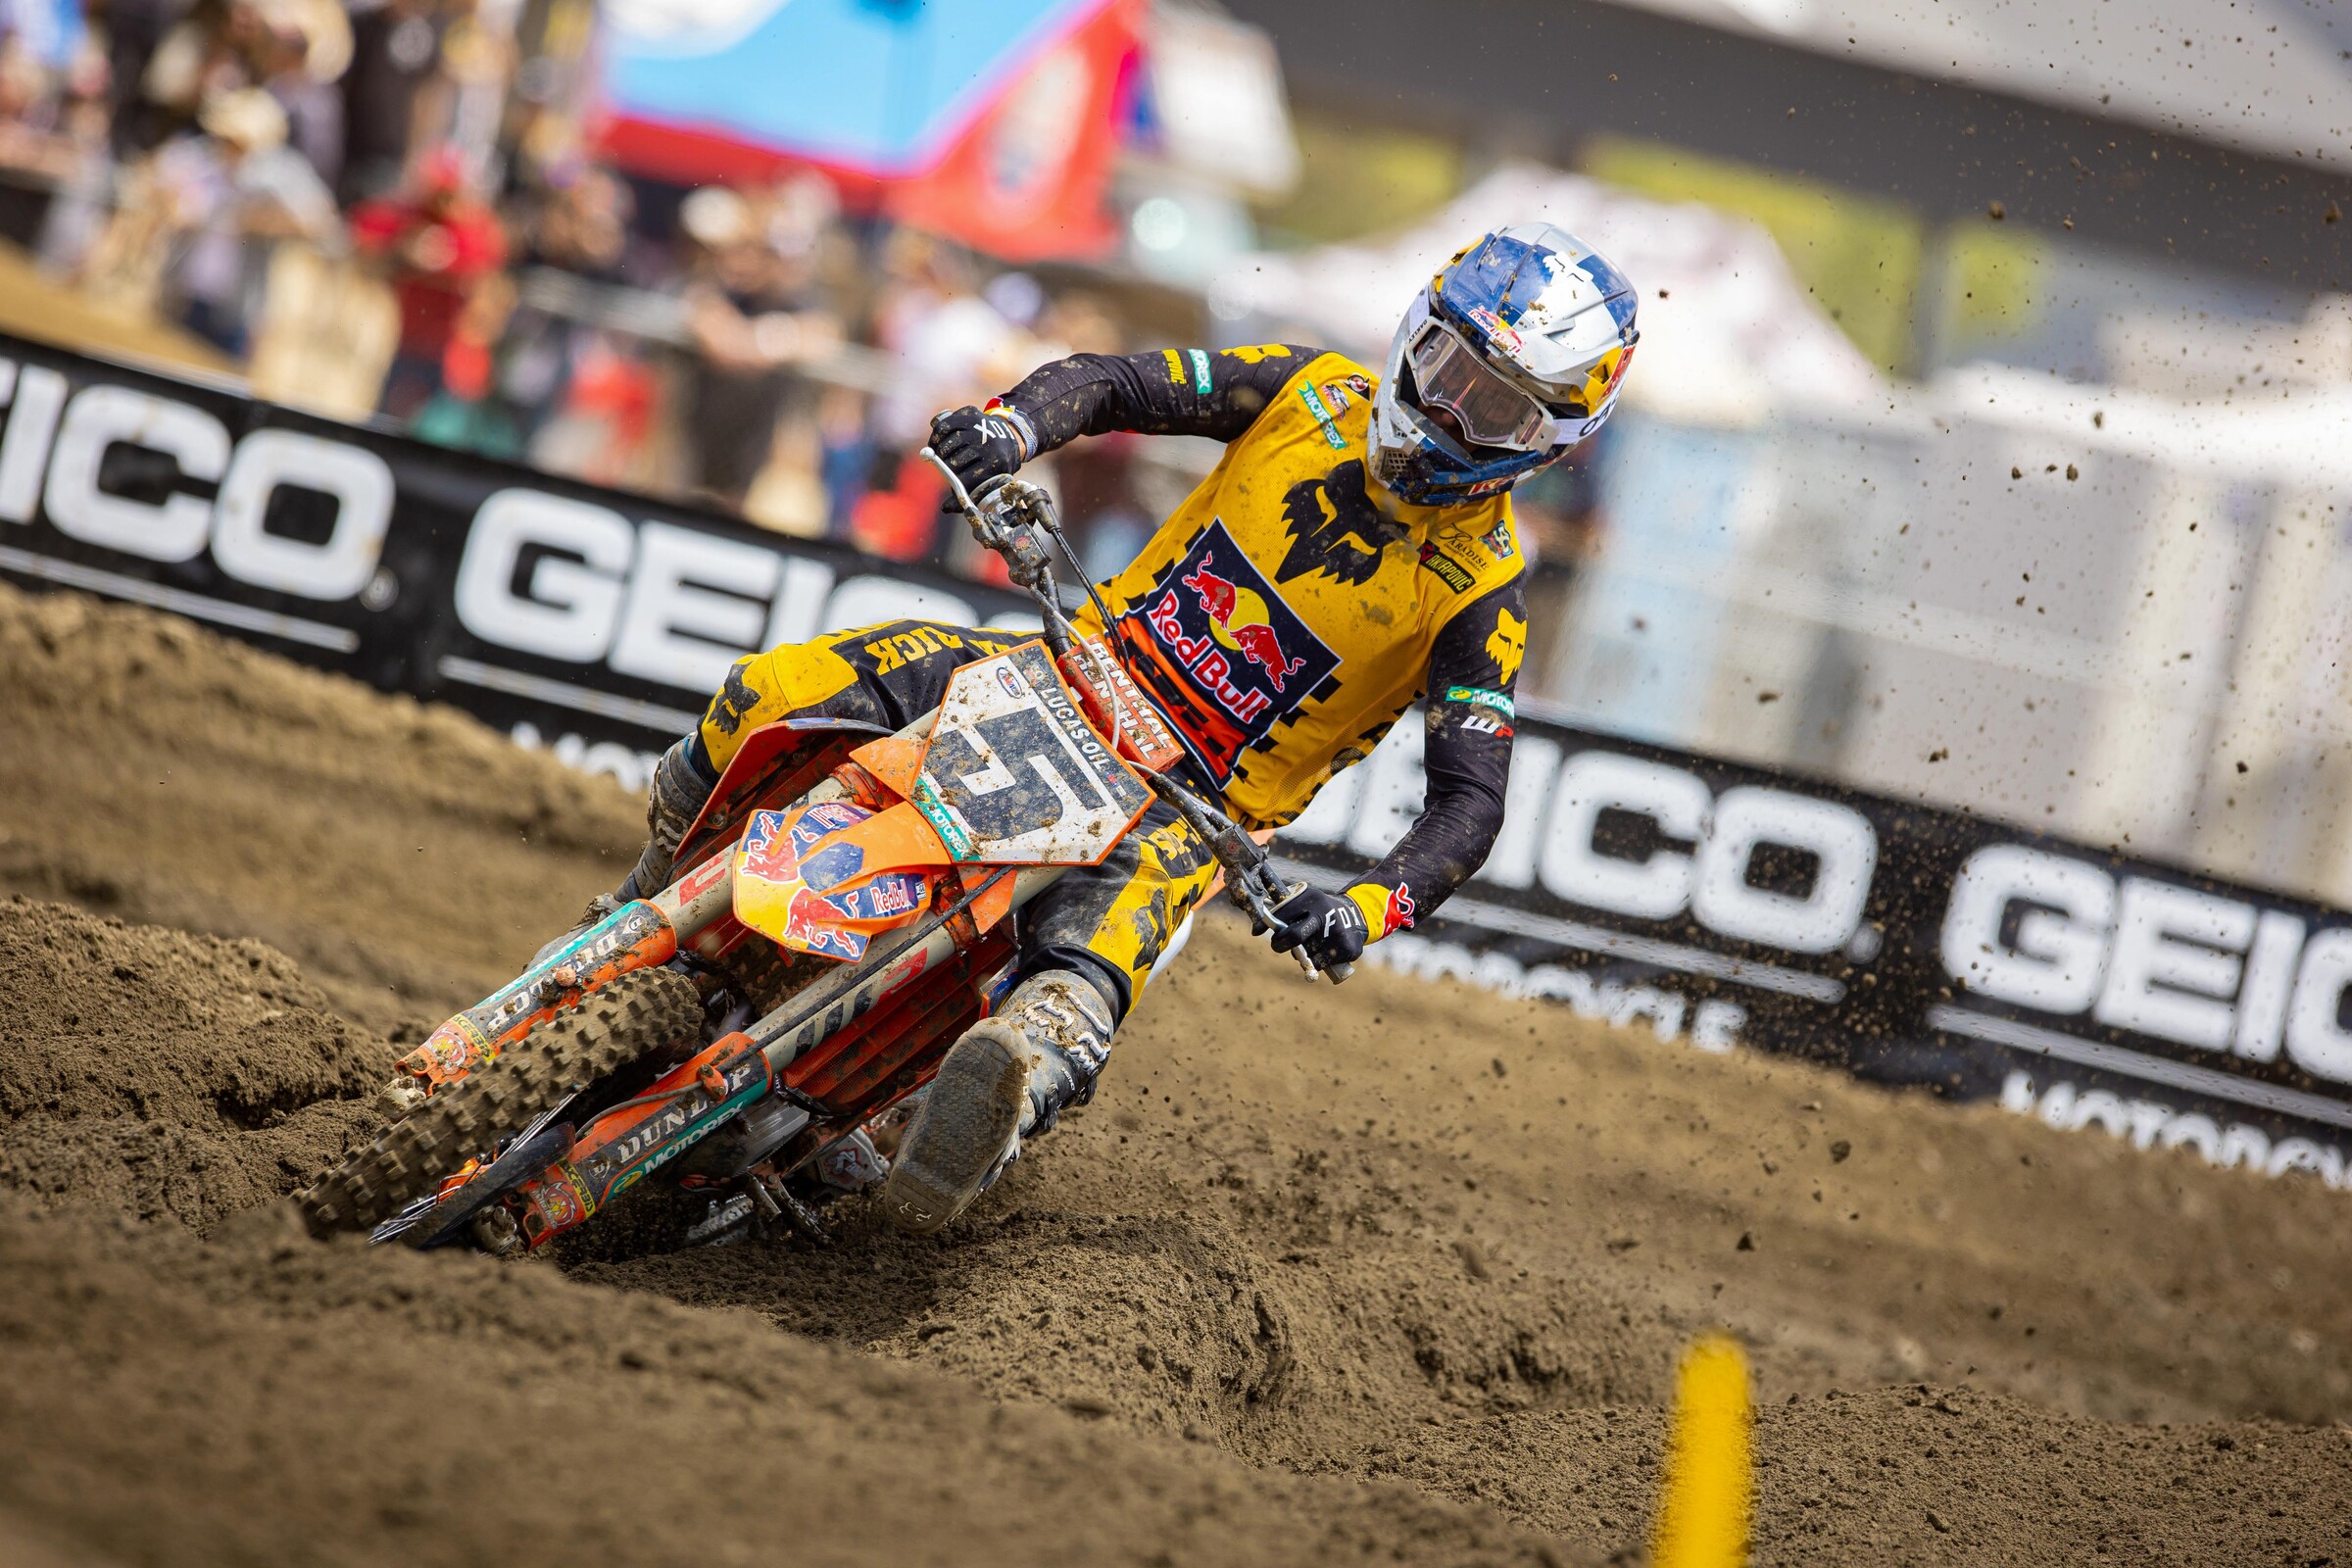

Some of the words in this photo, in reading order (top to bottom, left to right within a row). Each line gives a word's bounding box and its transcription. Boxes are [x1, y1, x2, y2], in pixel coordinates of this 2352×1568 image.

[0, 358, 396, 601] ICO
[453, 488, 1049, 698] GEI
[1041, 687, 1090, 739] LUCAS
[1081, 742, 1110, 770] OIL
[1090, 642, 1171, 748] RENTHAL
[924, 706, 1106, 841] 5
[617, 1065, 752, 1163] DUNLP
[644, 1101, 745, 1175] MOTOREX
